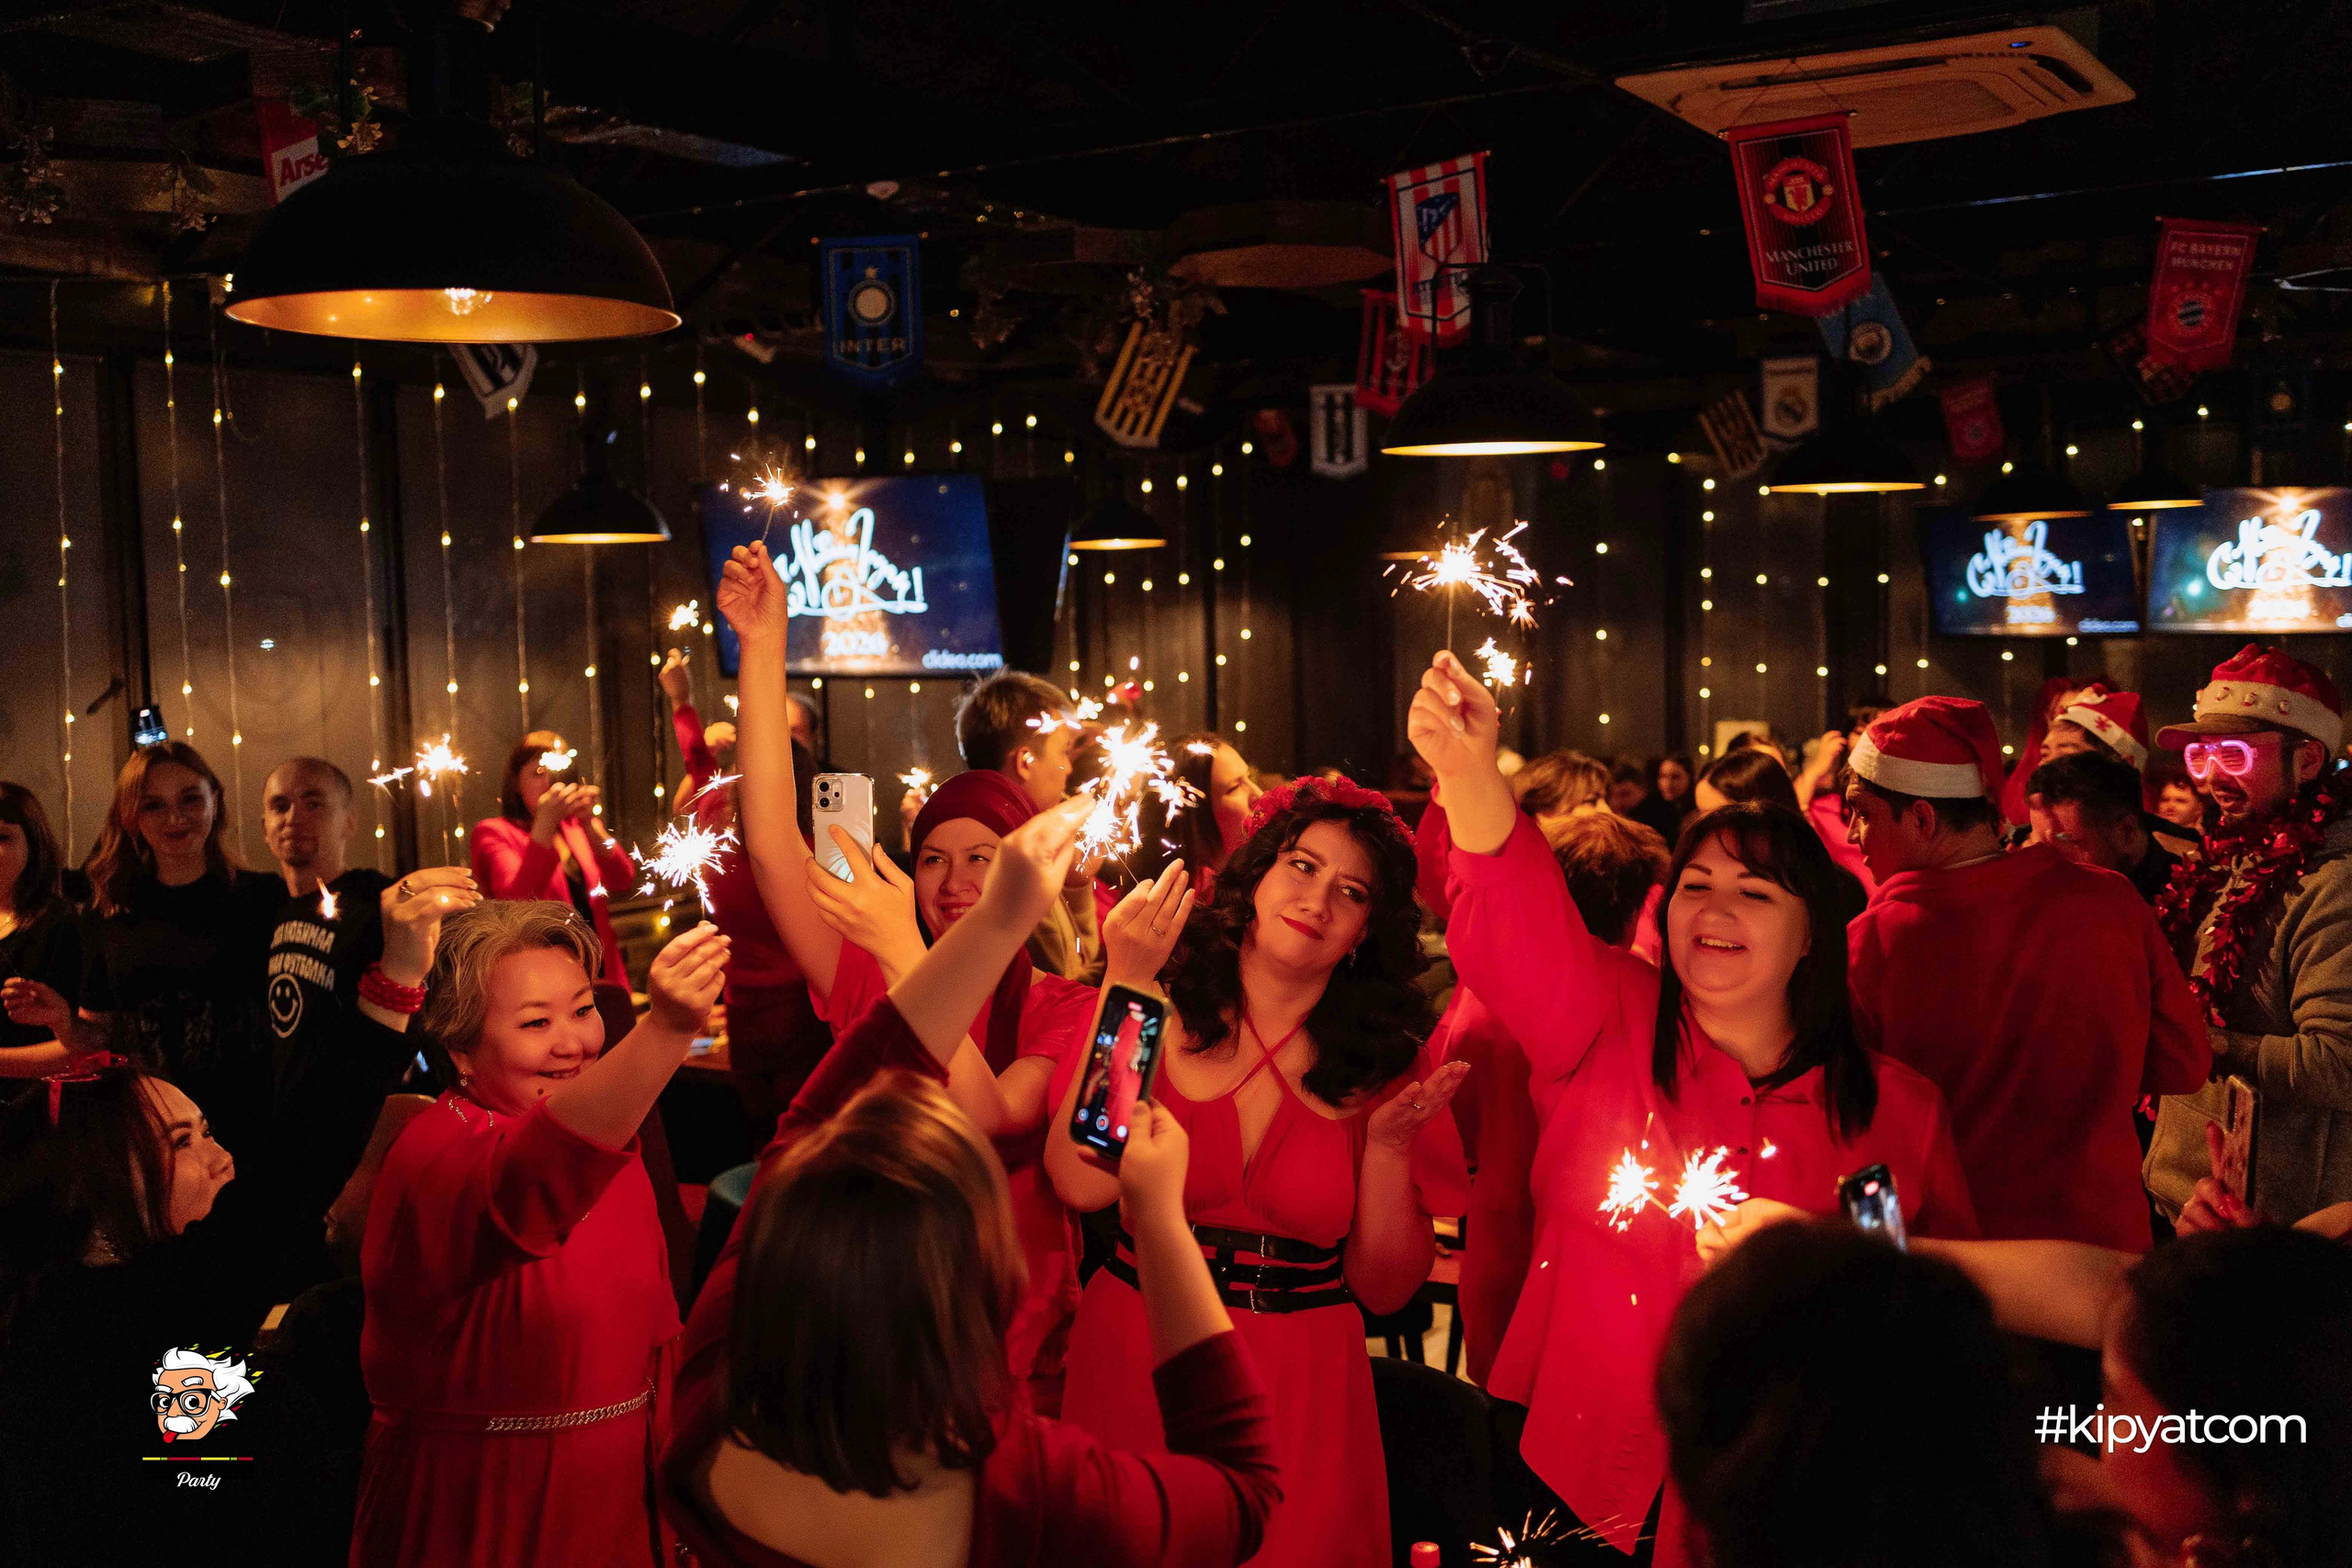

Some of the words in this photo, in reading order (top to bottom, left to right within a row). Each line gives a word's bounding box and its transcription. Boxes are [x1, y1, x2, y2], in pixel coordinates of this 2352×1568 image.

[1765, 241, 1854, 263] MANCHESTER
[1786, 258, 1838, 276] UNITED
[840, 337, 906, 354] INTER
